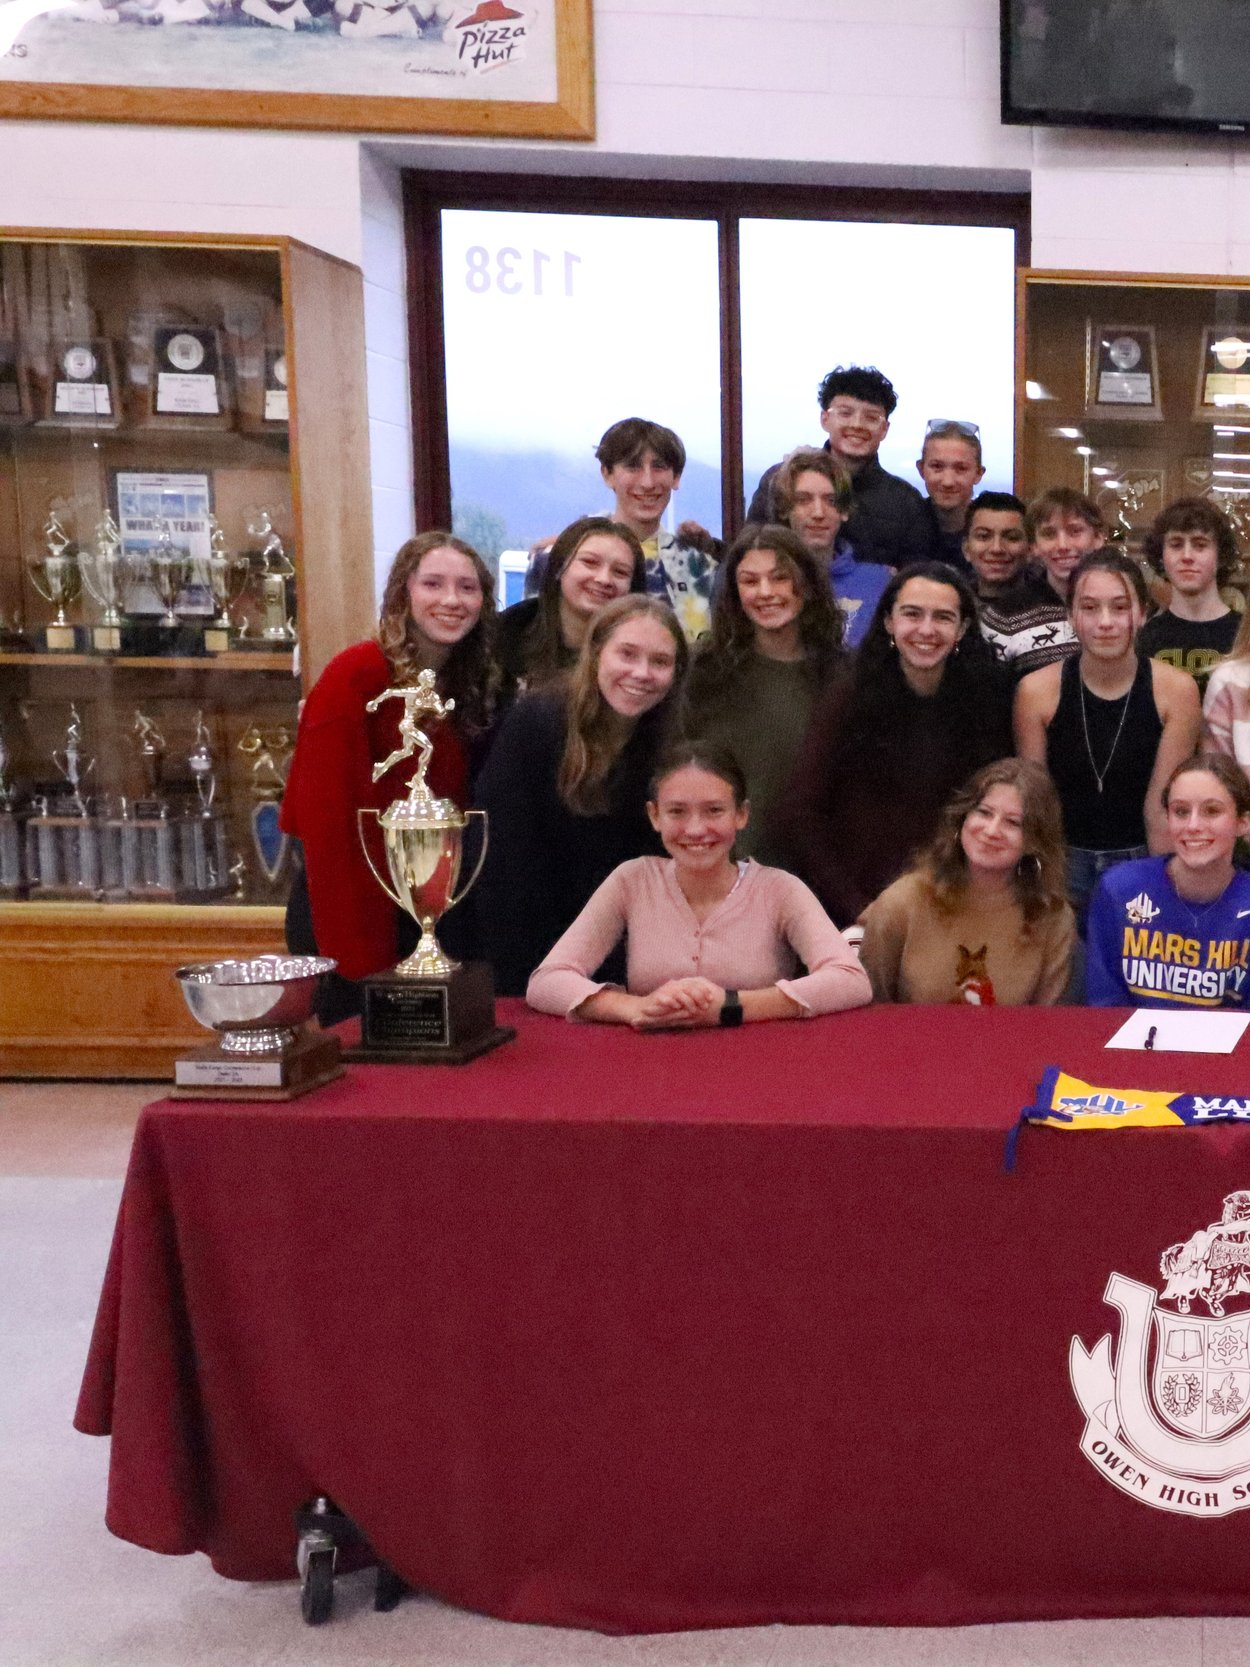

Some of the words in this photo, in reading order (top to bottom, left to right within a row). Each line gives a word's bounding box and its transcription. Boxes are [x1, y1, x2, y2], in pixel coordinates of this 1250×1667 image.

[459, 22, 527, 60] Pizza
[472, 42, 519, 69] Hut
[1123, 927, 1201, 967] MARS
[1206, 937, 1250, 970] HILL
[1092, 1440, 1150, 1490] OWEN
[1158, 1484, 1219, 1507] HIGH
